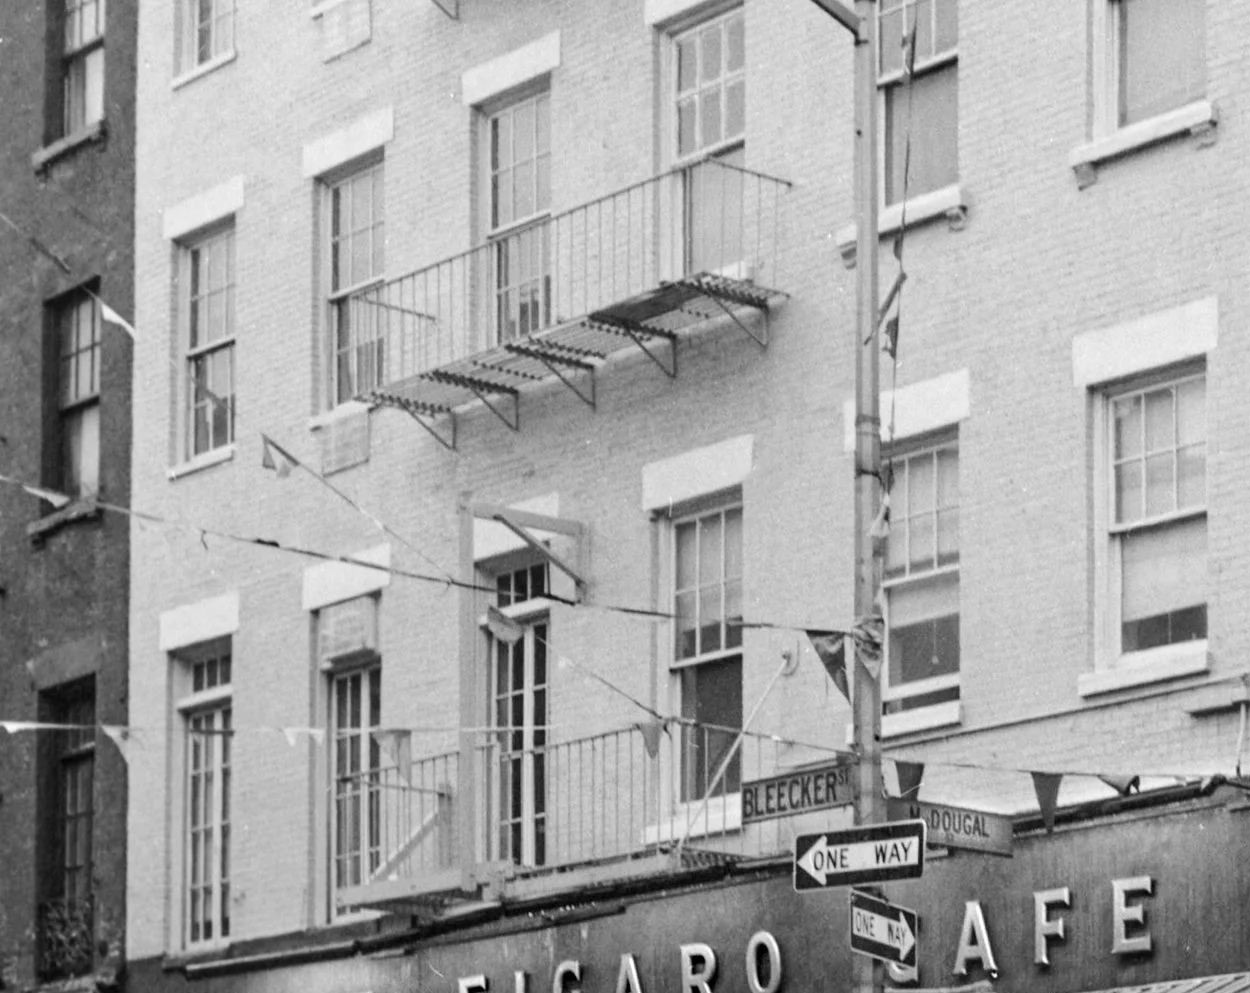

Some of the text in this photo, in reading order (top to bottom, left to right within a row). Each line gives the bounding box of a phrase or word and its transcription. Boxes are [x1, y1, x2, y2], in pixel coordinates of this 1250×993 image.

[742, 771, 837, 819] BLEECKER
[813, 840, 912, 871] ONE WAY
[855, 911, 908, 949] ONE WAY
[888, 875, 1153, 983] AFE
